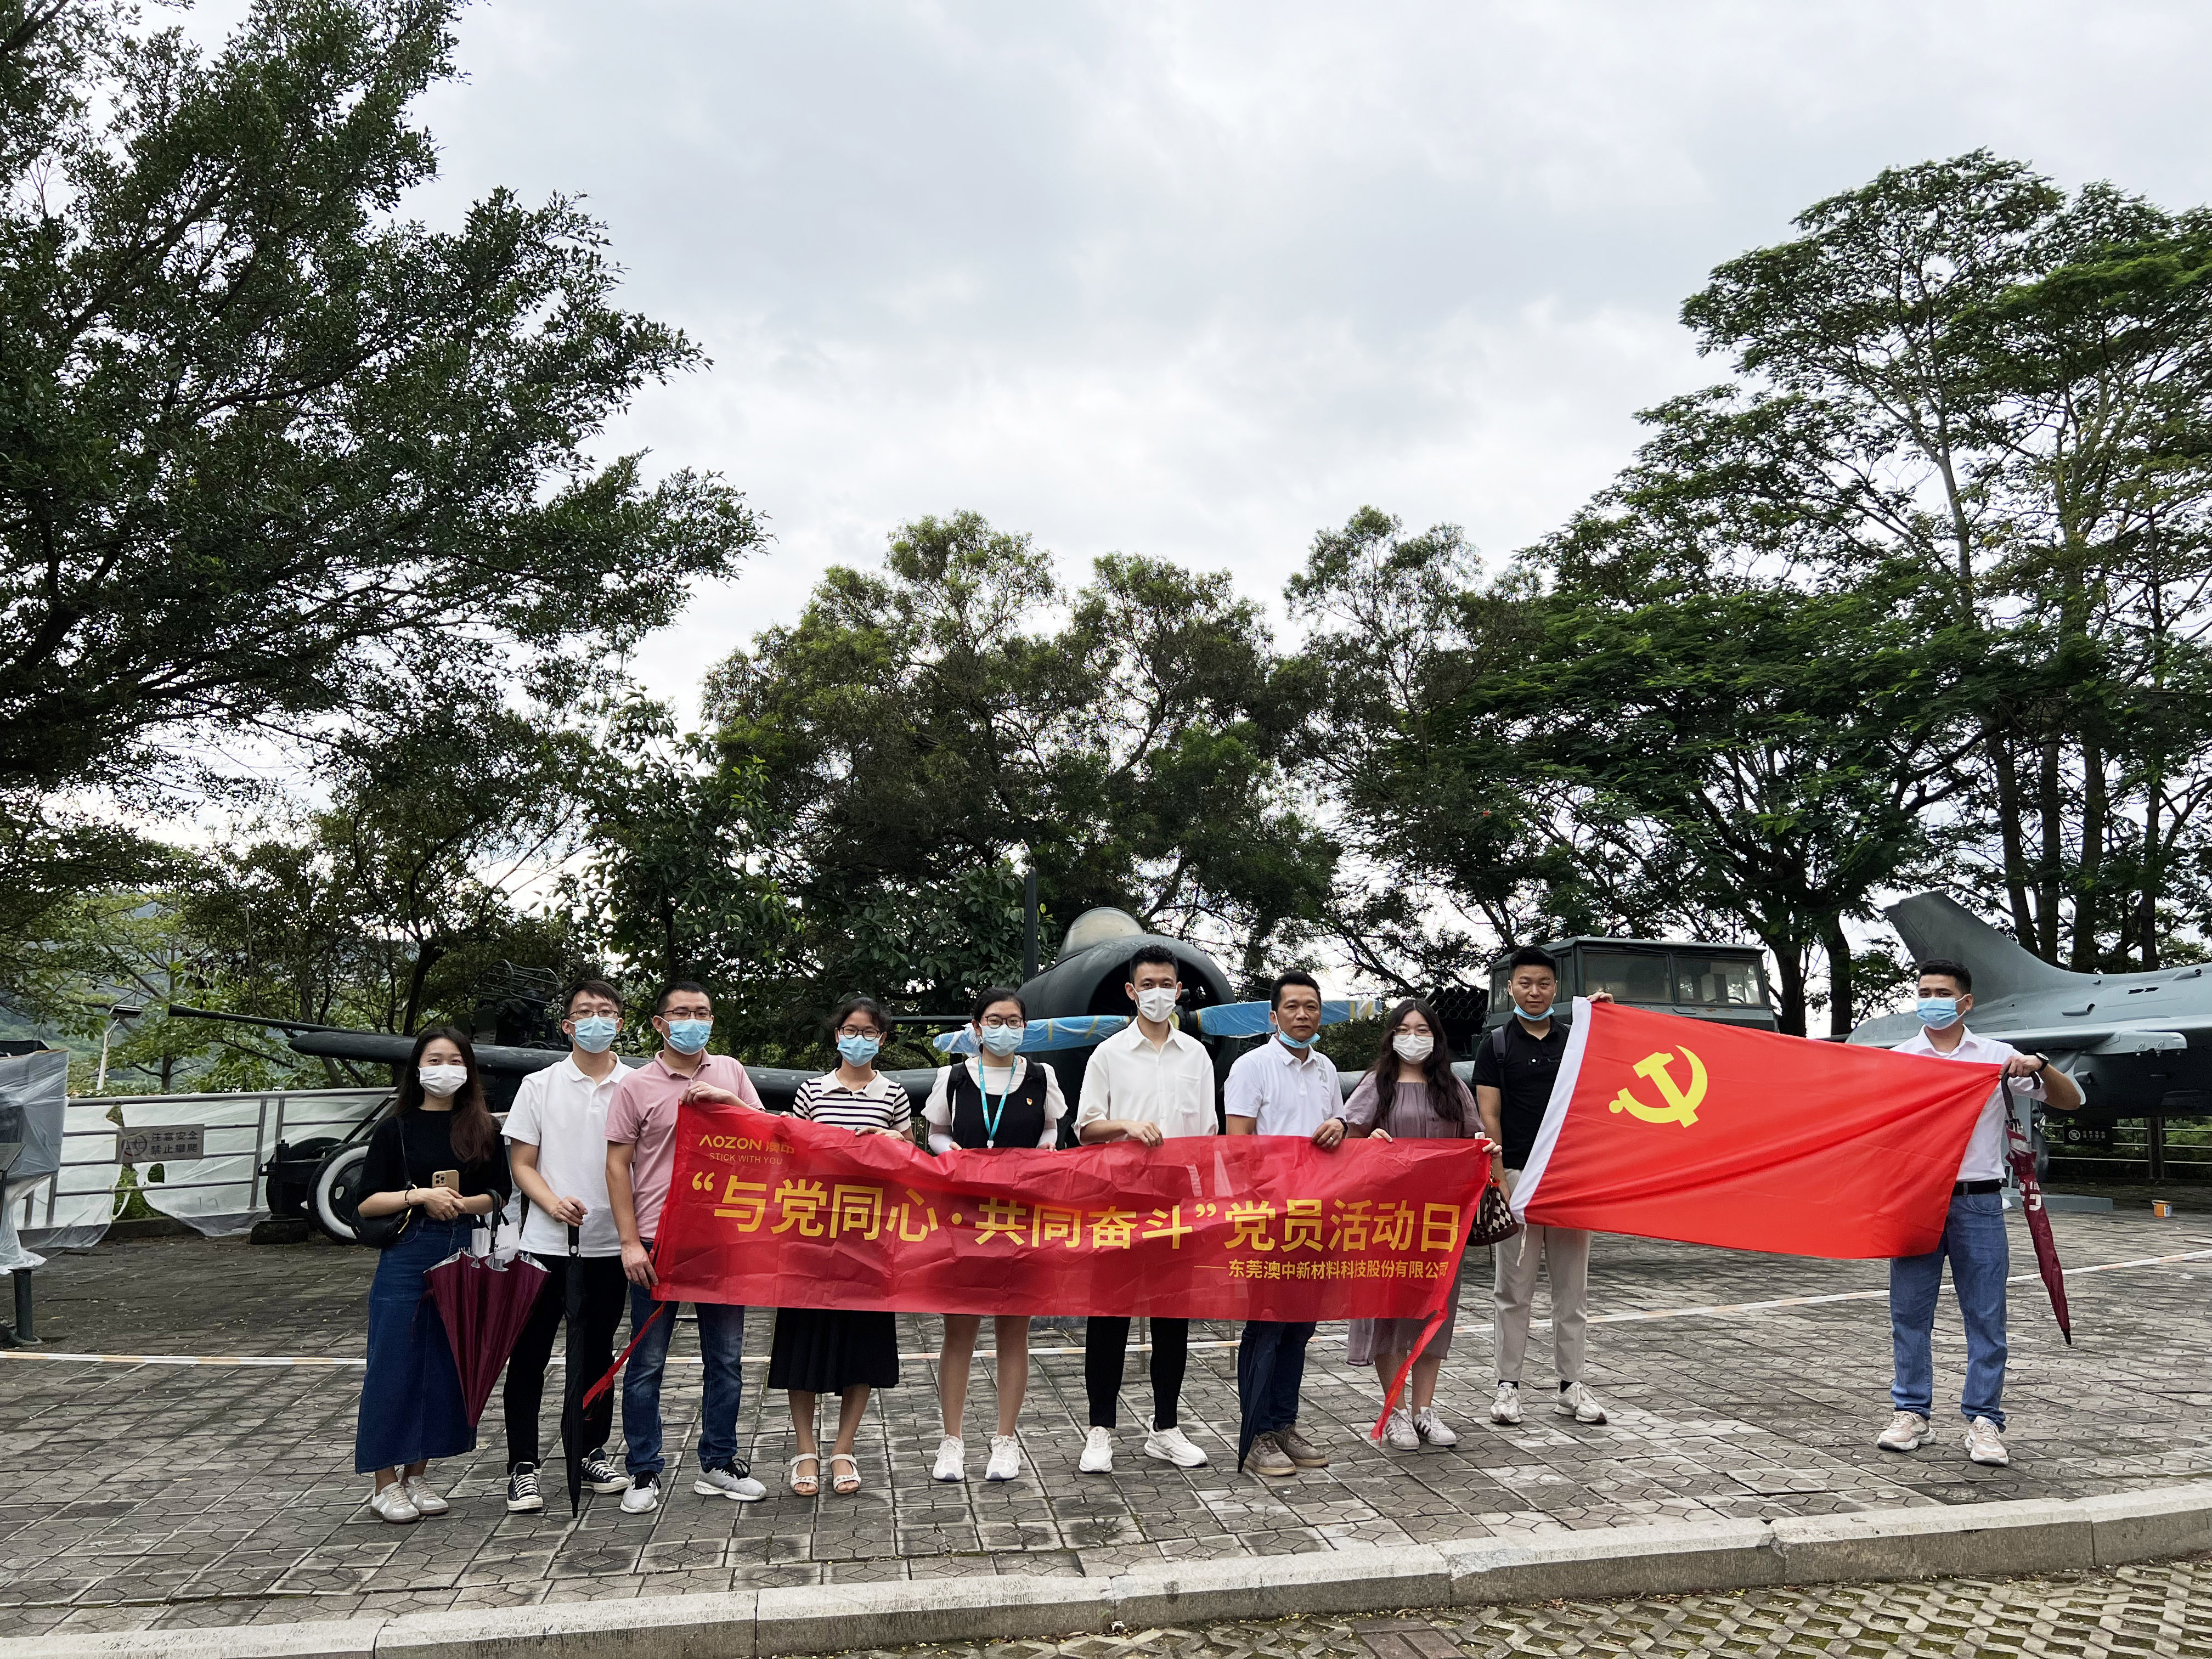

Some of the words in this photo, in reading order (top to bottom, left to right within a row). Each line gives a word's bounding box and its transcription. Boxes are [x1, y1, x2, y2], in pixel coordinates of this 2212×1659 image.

[151, 1131, 198, 1142] 注意安全
[699, 1135, 762, 1150] AOZON
[150, 1143, 198, 1155] 禁止攀爬
[709, 1153, 736, 1162] STICK
[738, 1154, 761, 1164] WITH
[764, 1156, 782, 1165] YOU
